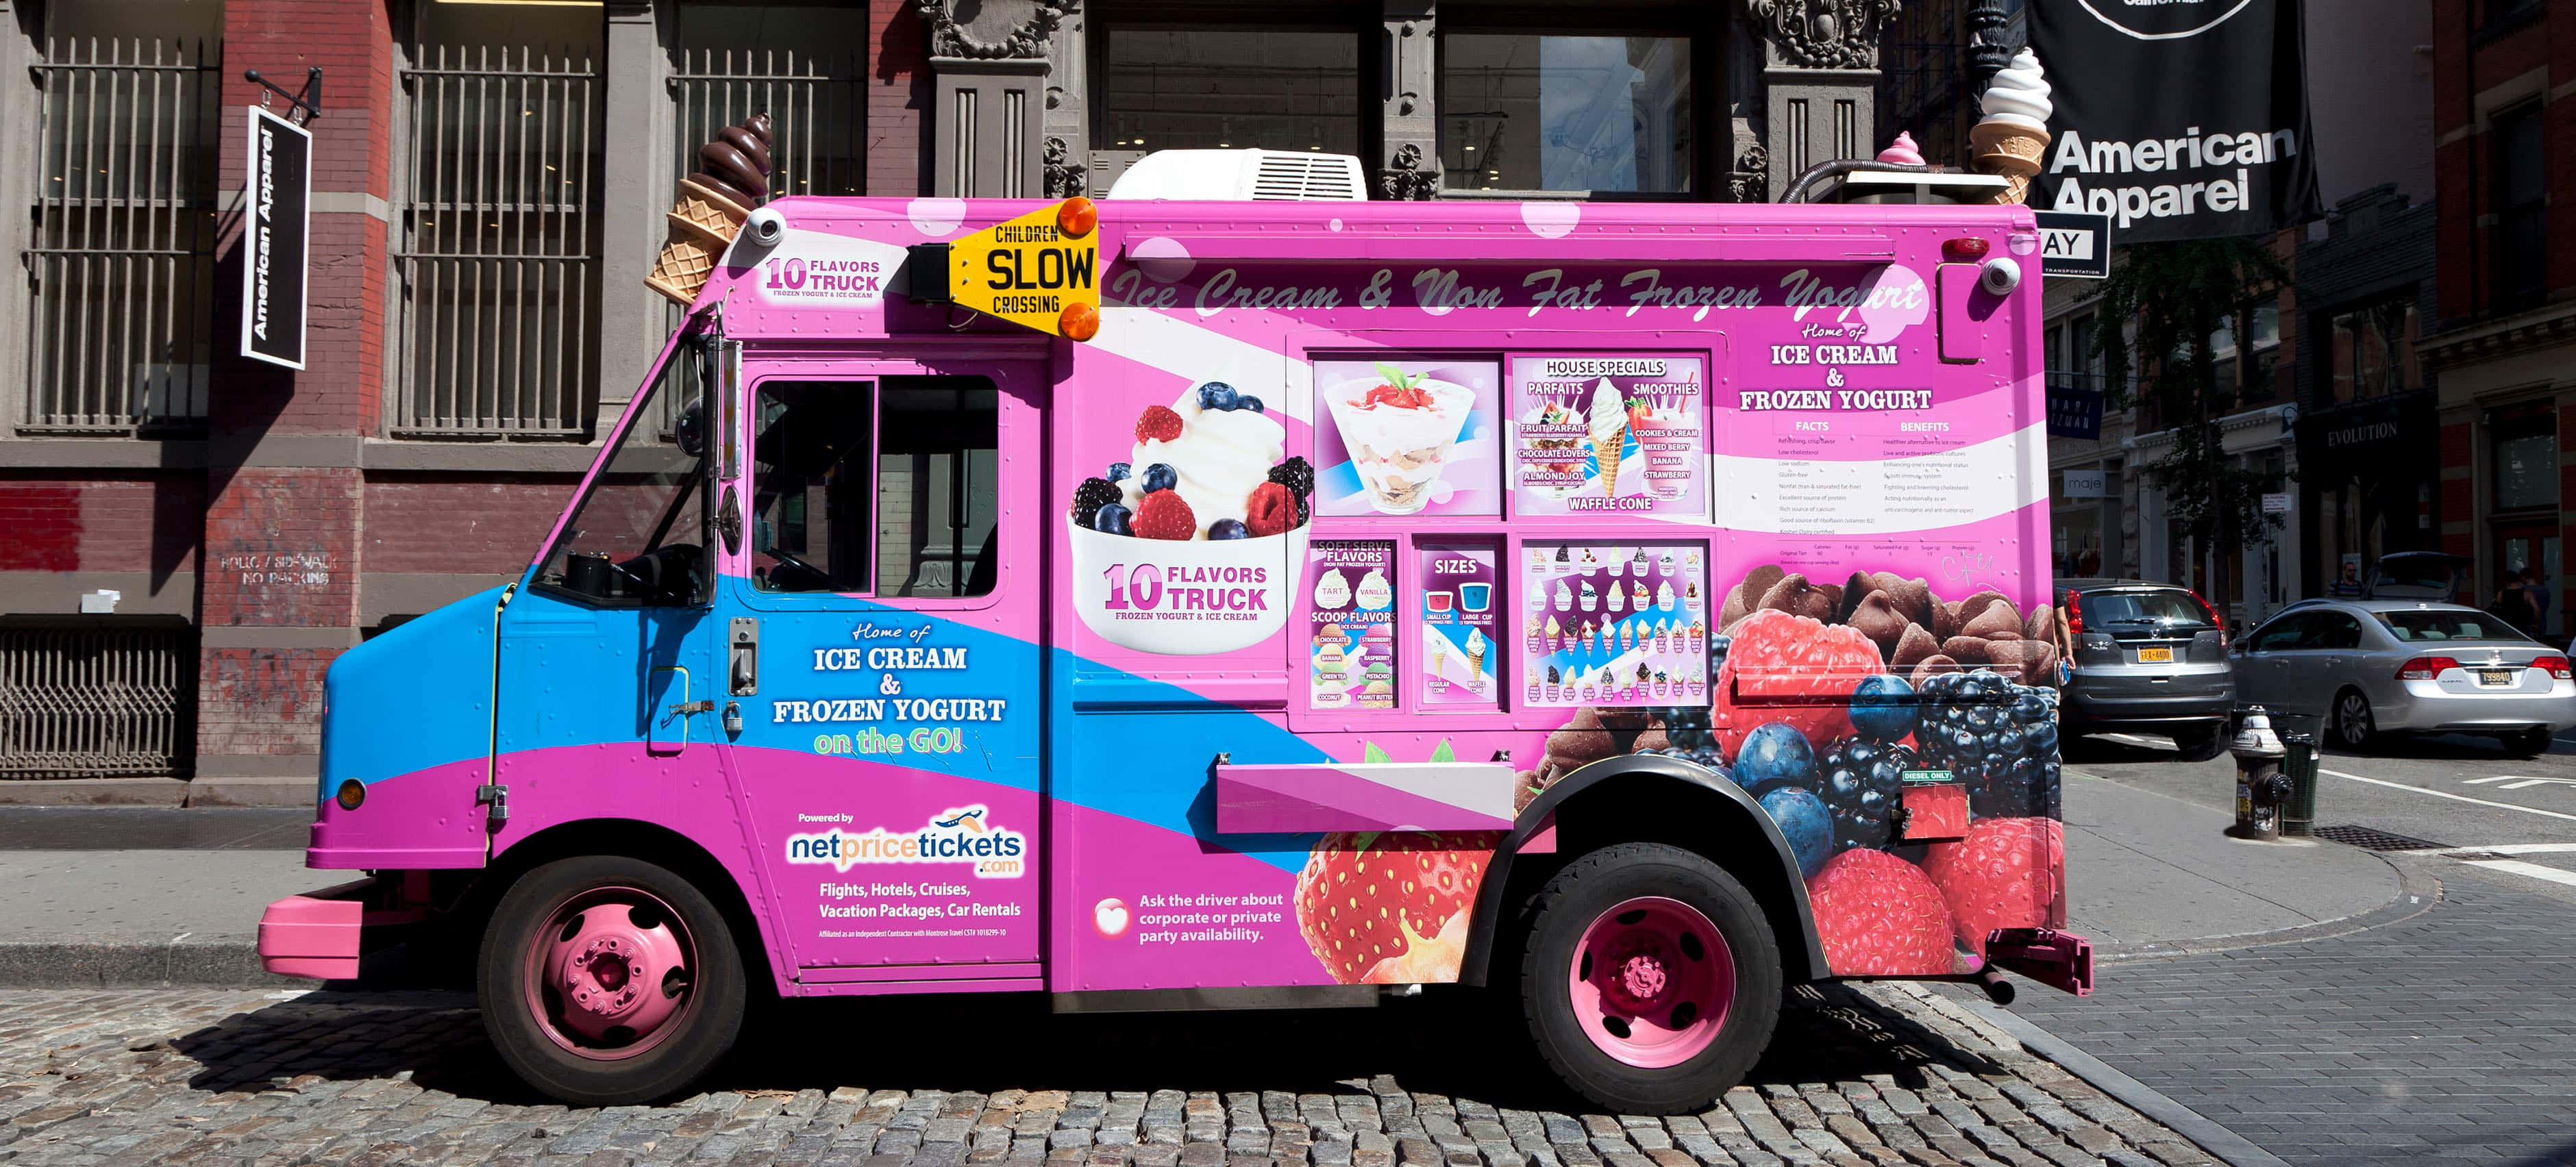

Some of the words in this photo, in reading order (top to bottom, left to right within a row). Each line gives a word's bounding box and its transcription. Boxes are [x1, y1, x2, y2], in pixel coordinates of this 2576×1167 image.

[2049, 126, 2296, 174] American
[258, 128, 273, 223] Apparel
[2053, 168, 2249, 229] Apparel
[995, 225, 1058, 242] CHILDREN
[2038, 232, 2080, 255] AY
[766, 258, 807, 289] 10
[810, 260, 880, 273] FLAVORS
[987, 247, 1094, 290] SLOW
[254, 226, 270, 340] American
[810, 275, 880, 291] TRUCK
[1113, 269, 1178, 310] Ice
[1195, 268, 1342, 316] Cream
[1359, 268, 1392, 310] &
[1412, 268, 1504, 310] Non
[1522, 268, 1602, 318] Fat
[1620, 268, 1763, 323] Frozen
[1780, 268, 1924, 323] Yogurt
[993, 296, 1059, 314] CROSSING
[1803, 323, 1844, 340] Home
[1848, 325, 1867, 342] of
[1771, 346, 1811, 365] ICE
[1816, 345, 1898, 364] CREAM
[1547, 361, 1594, 373] HOUSE
[1599, 361, 1664, 373] SPECIALS
[1826, 368, 1844, 387] &
[1528, 383, 1583, 394] PARFAITS
[1633, 384, 1698, 395] SMOOTHIES
[1739, 390, 1831, 411] FROZEN
[1840, 390, 1932, 410] YOGURT
[1796, 421, 1829, 431] FACTS
[1900, 422, 1949, 431] BENEFITS
[2328, 422, 2397, 447] EVOLUTION
[2069, 477, 2101, 490] maje
[1569, 498, 1615, 510] WAFFLE
[1618, 498, 1652, 510] CONE
[1318, 541, 1349, 551] SOFT
[1353, 541, 1391, 551] SERVE
[1327, 552, 1383, 562] FLAVORS
[1435, 560, 1477, 574] SIZES
[243, 572, 264, 585] NO
[1103, 563, 1163, 611] 10
[1167, 566, 1267, 583] FLAVORS
[1167, 588, 1267, 611] TRUCK
[1156, 612, 1193, 620] YOGURT
[1311, 612, 1347, 622] SCOOP
[1350, 612, 1396, 622] FLAVORS
[852, 623, 902, 640] Home
[910, 625, 931, 643] of
[814, 649, 860, 670] ICE
[868, 648, 967, 669] CREAM
[880, 673, 901, 694] &
[773, 700, 885, 723] FROZEN
[893, 699, 1005, 721] YOGURT
[815, 734, 852, 754] on
[856, 727, 904, 753] the
[909, 727, 962, 753] GO!
[798, 814, 839, 823] Powered
[841, 814, 854, 824] by
[792, 832, 1021, 866] netpricetickets
[980, 859, 1019, 873] .com
[820, 883, 868, 900] Flights,
[871, 883, 917, 898] Hotels,
[920, 882, 971, 897] Cruises,
[1140, 894, 1165, 907] Ask
[1168, 894, 1192, 906] the
[1196, 894, 1238, 906] driver
[1241, 893, 1283, 905] about
[819, 904, 877, 918] Vacation
[880, 903, 945, 920] Packages,
[948, 903, 969, 916] Car
[972, 903, 1021, 916] Rentals
[1140, 912, 1209, 927] corporate
[1213, 913, 1227, 923] or
[1230, 911, 1281, 926] private
[1140, 930, 1178, 944] party
[1181, 927, 1264, 943] availability.
